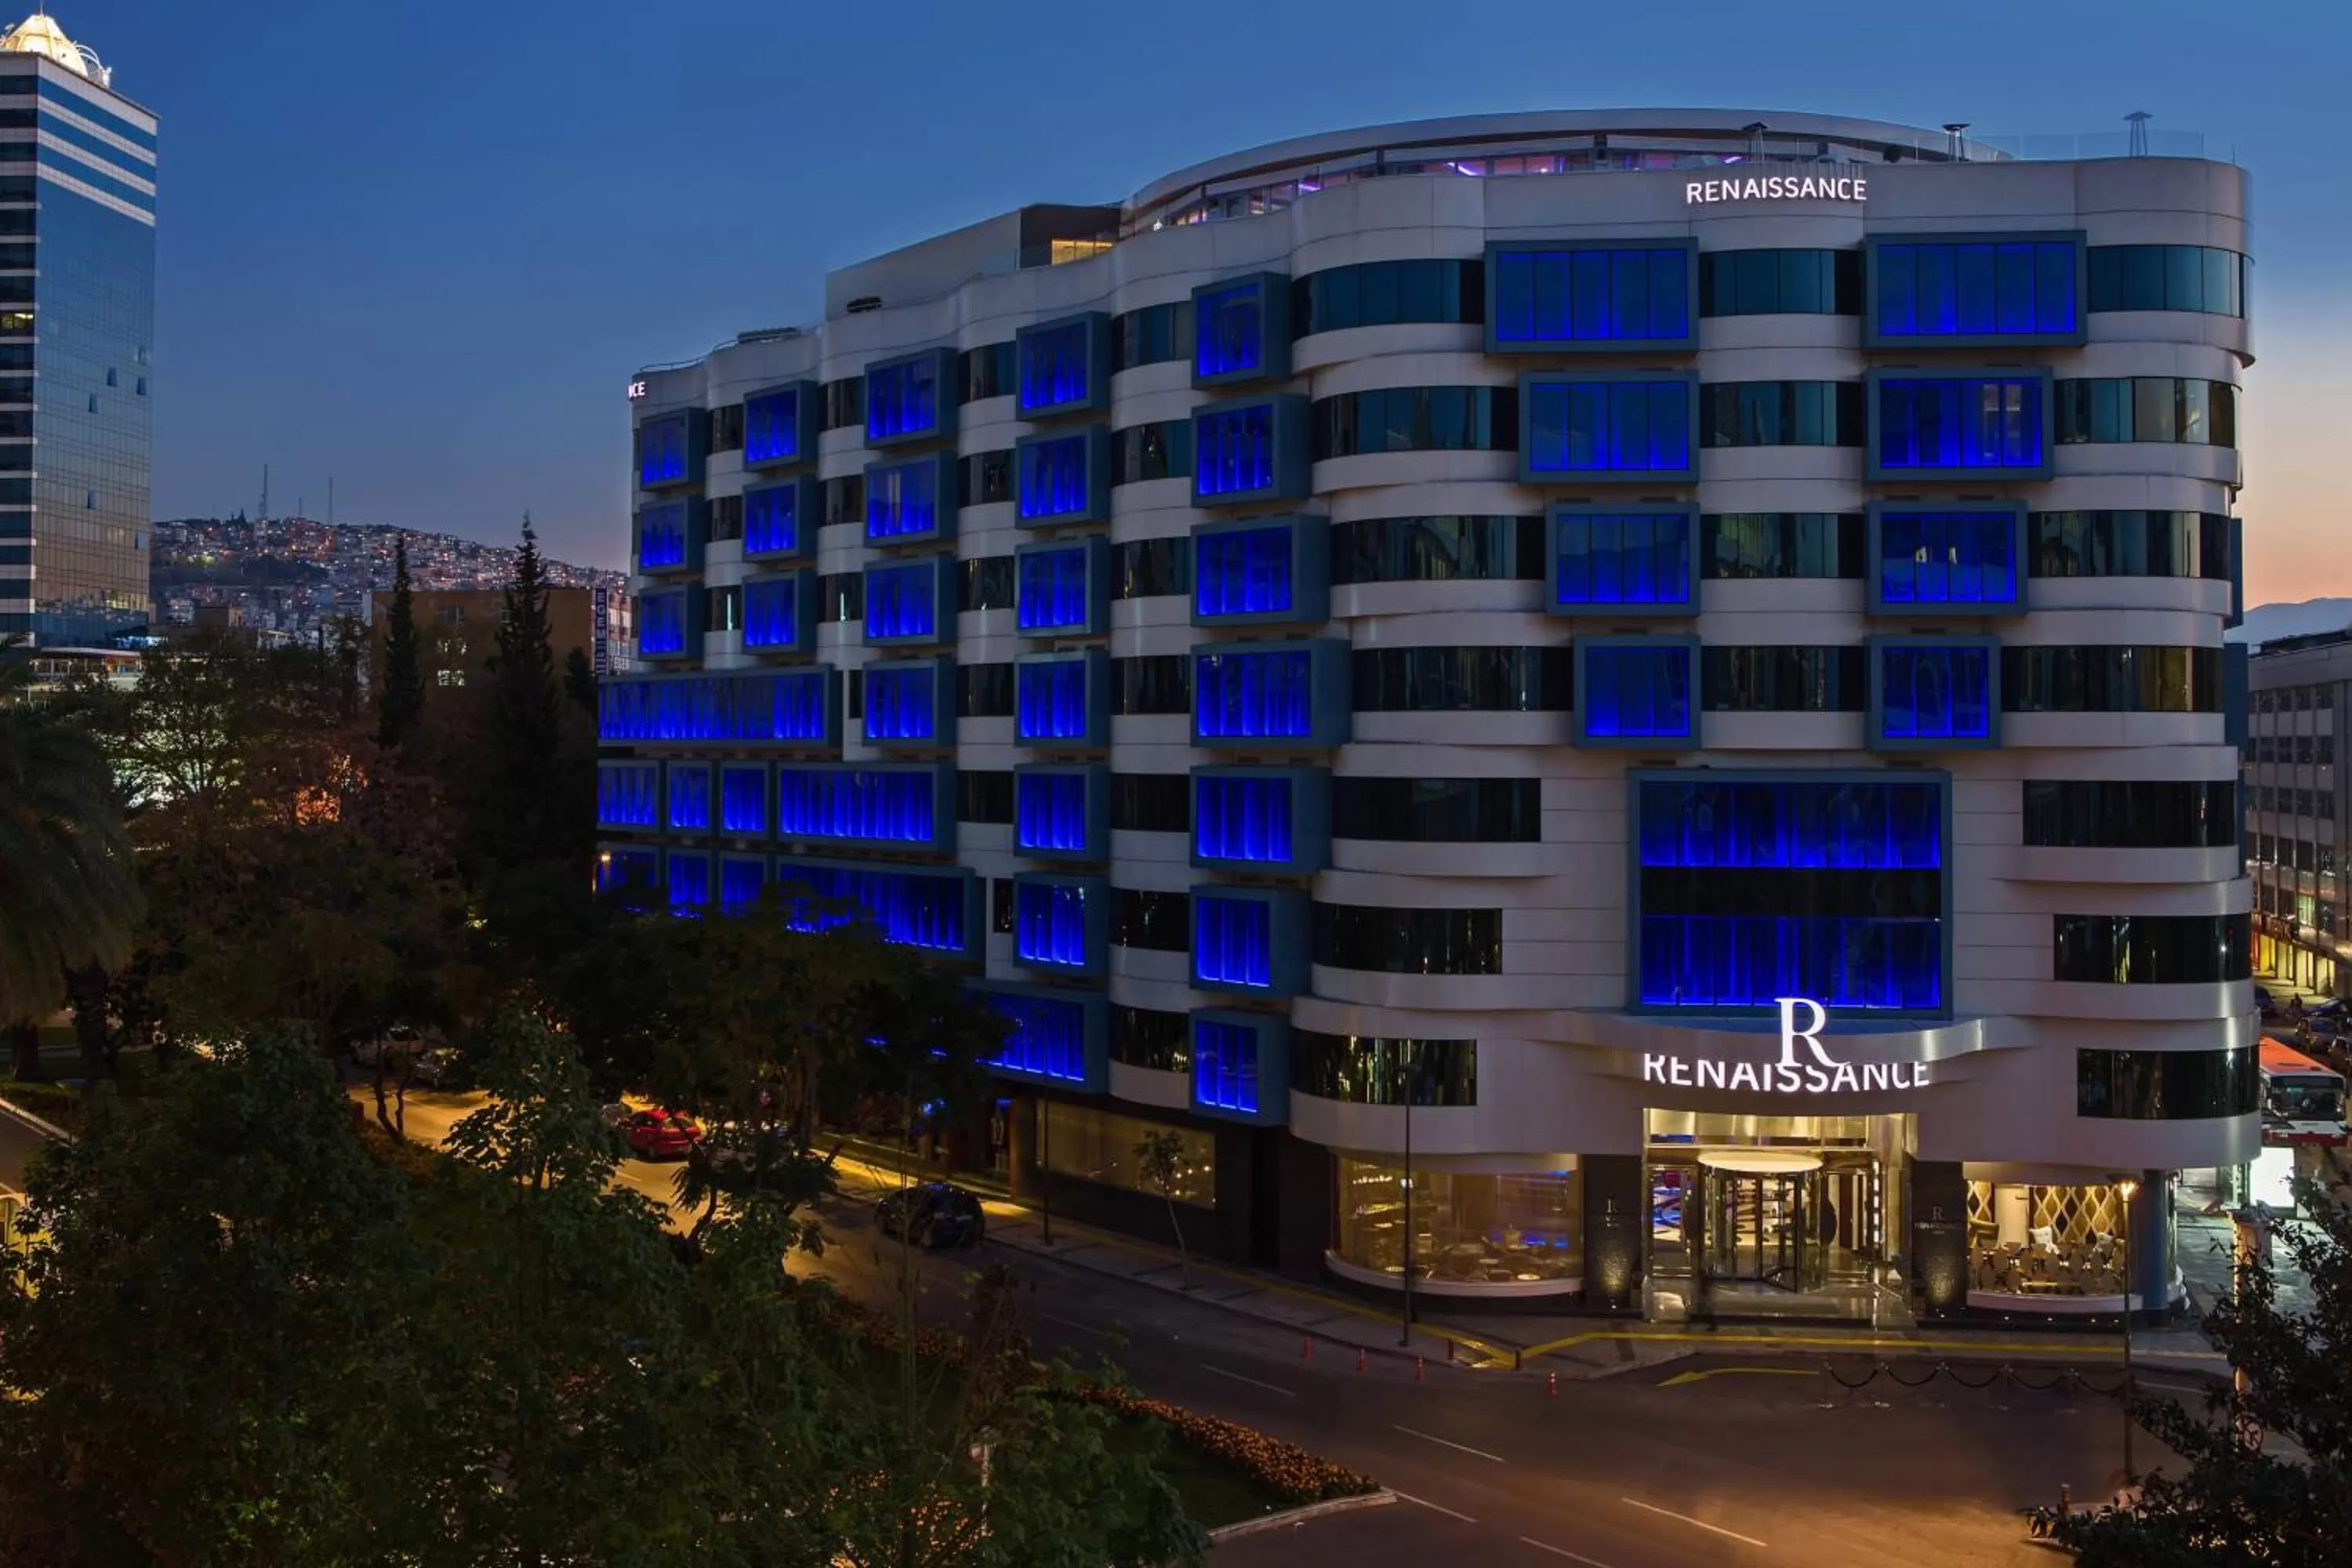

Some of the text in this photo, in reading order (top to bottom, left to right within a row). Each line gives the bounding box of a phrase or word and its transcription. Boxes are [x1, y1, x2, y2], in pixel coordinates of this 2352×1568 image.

[1686, 176, 1867, 205] RENAISSANCE
[1774, 997, 1851, 1067] R
[1643, 1052, 1930, 1093] RENAISSANCE
